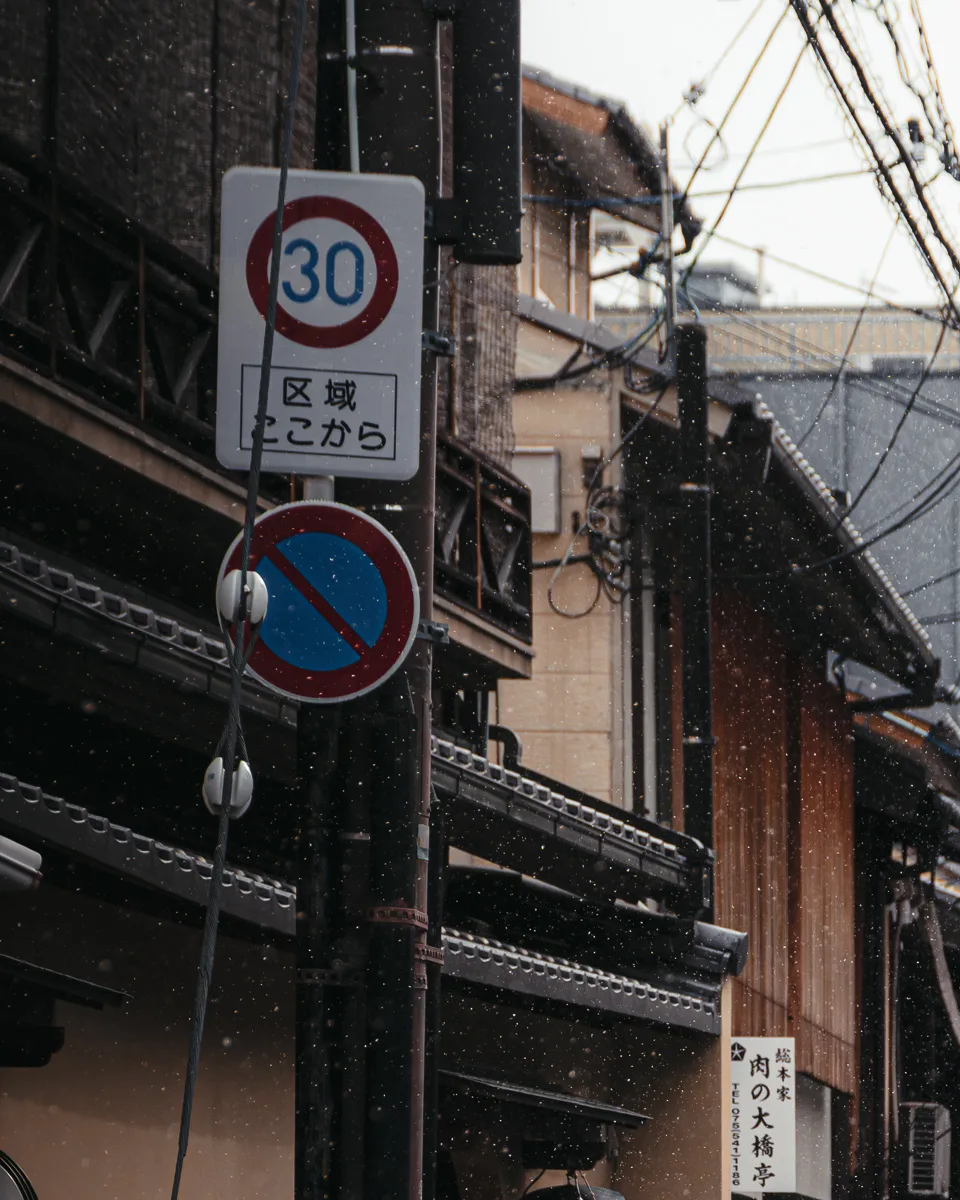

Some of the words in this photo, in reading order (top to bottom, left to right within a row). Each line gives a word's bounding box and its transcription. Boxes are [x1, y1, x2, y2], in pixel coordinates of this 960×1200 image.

[281, 238, 364, 306] 30
[283, 377, 357, 411] 区域
[251, 414, 387, 451] ここから
[732, 1083, 740, 1105] TEL
[775, 1048, 792, 1102] 総本家
[749, 1054, 775, 1187] 肉の大橋亭
